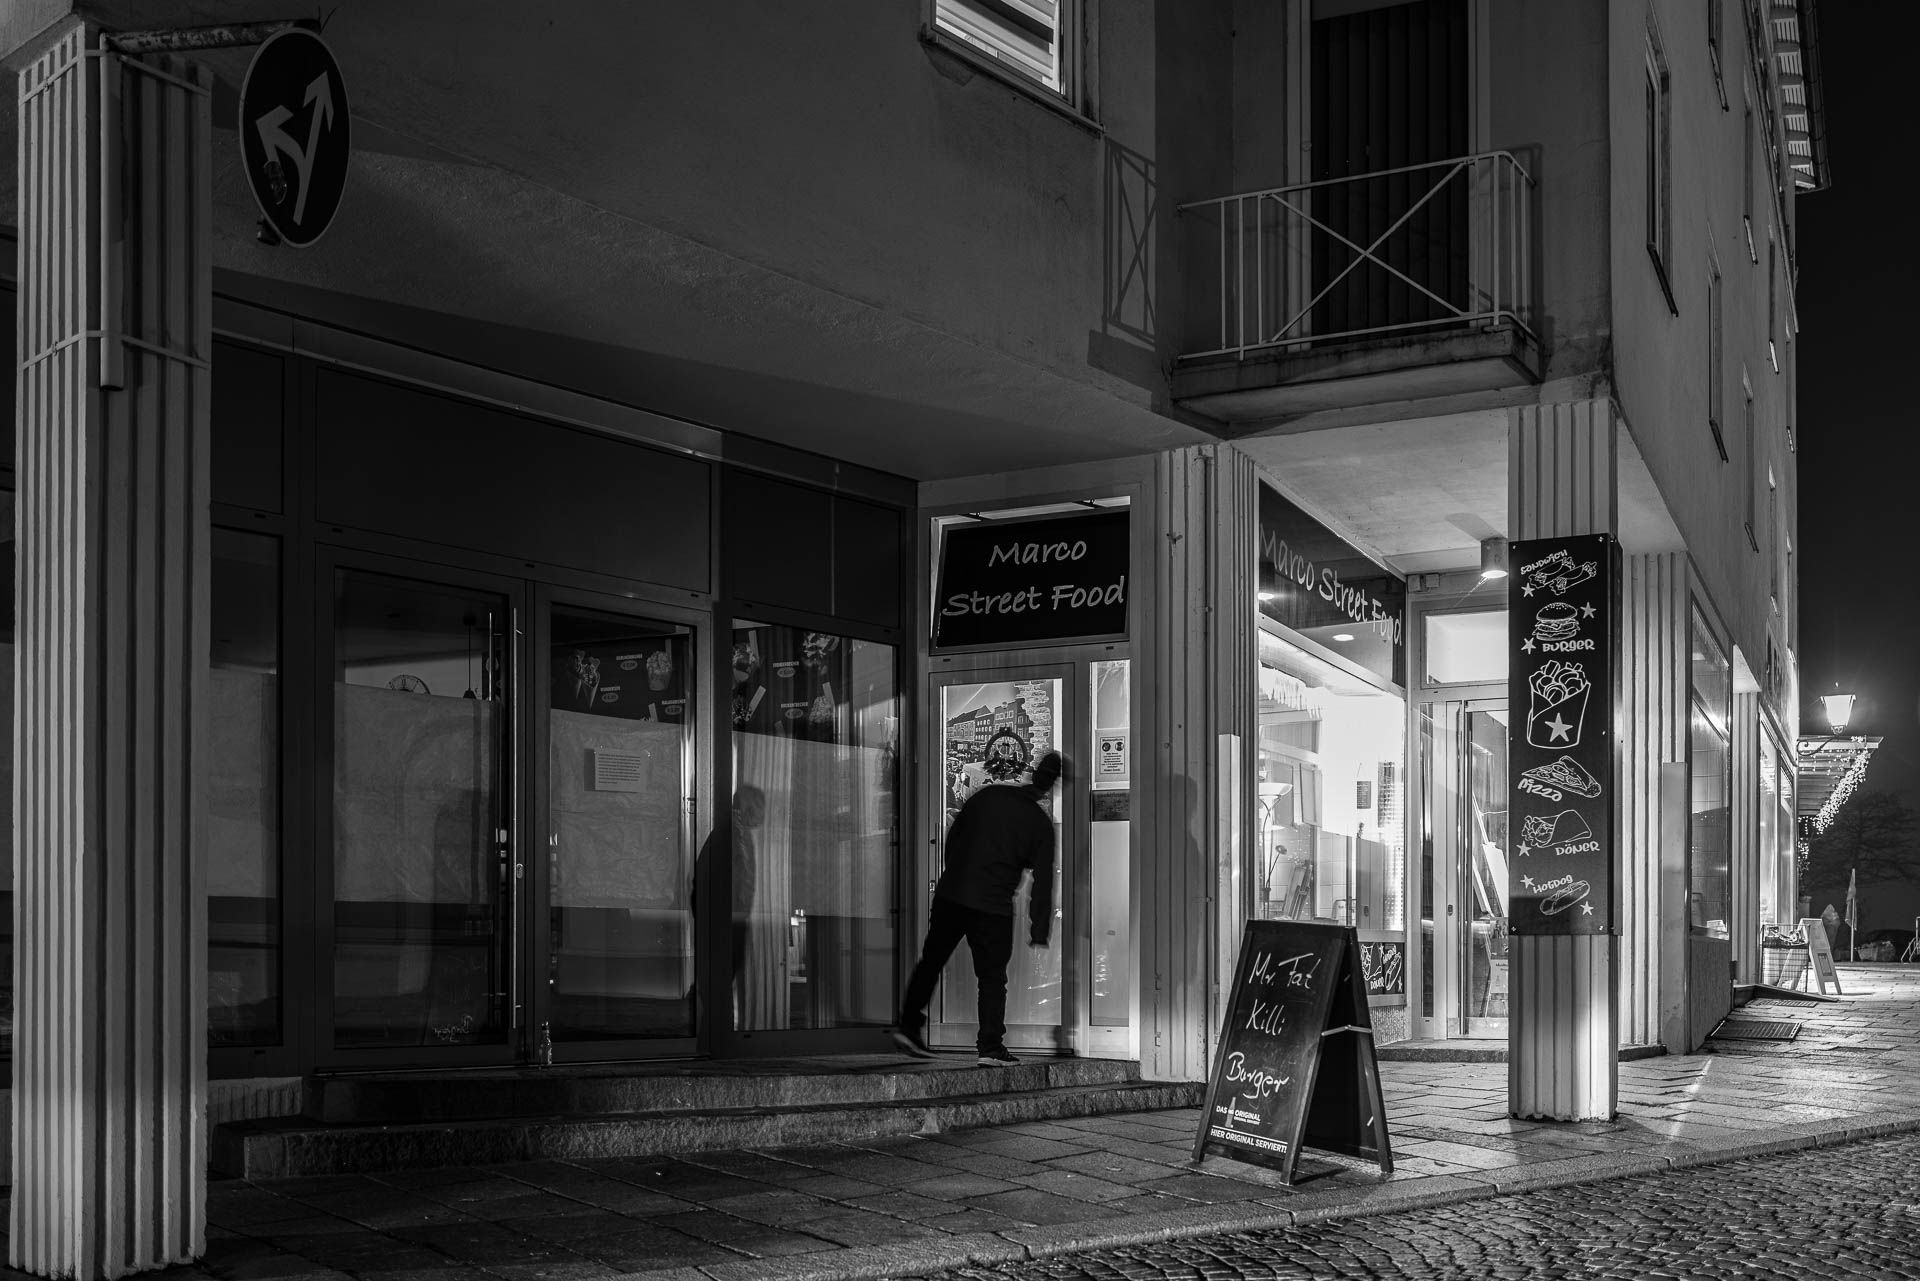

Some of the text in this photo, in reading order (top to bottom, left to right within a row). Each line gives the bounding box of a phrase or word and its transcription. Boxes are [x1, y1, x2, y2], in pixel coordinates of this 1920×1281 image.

[988, 540, 1087, 567] Marco
[942, 575, 1126, 616] Street Food
[1260, 523, 1403, 647] Marco Street Food
[1248, 951, 1276, 986] Mr.
[1245, 998, 1286, 1036] Killi
[1226, 1051, 1290, 1100] Burger
[1216, 1105, 1228, 1114] DAS
[1234, 1109, 1261, 1121] ORIGINAL
[1210, 1128, 1288, 1153] HIER ORIGINAL SERVIERT!
